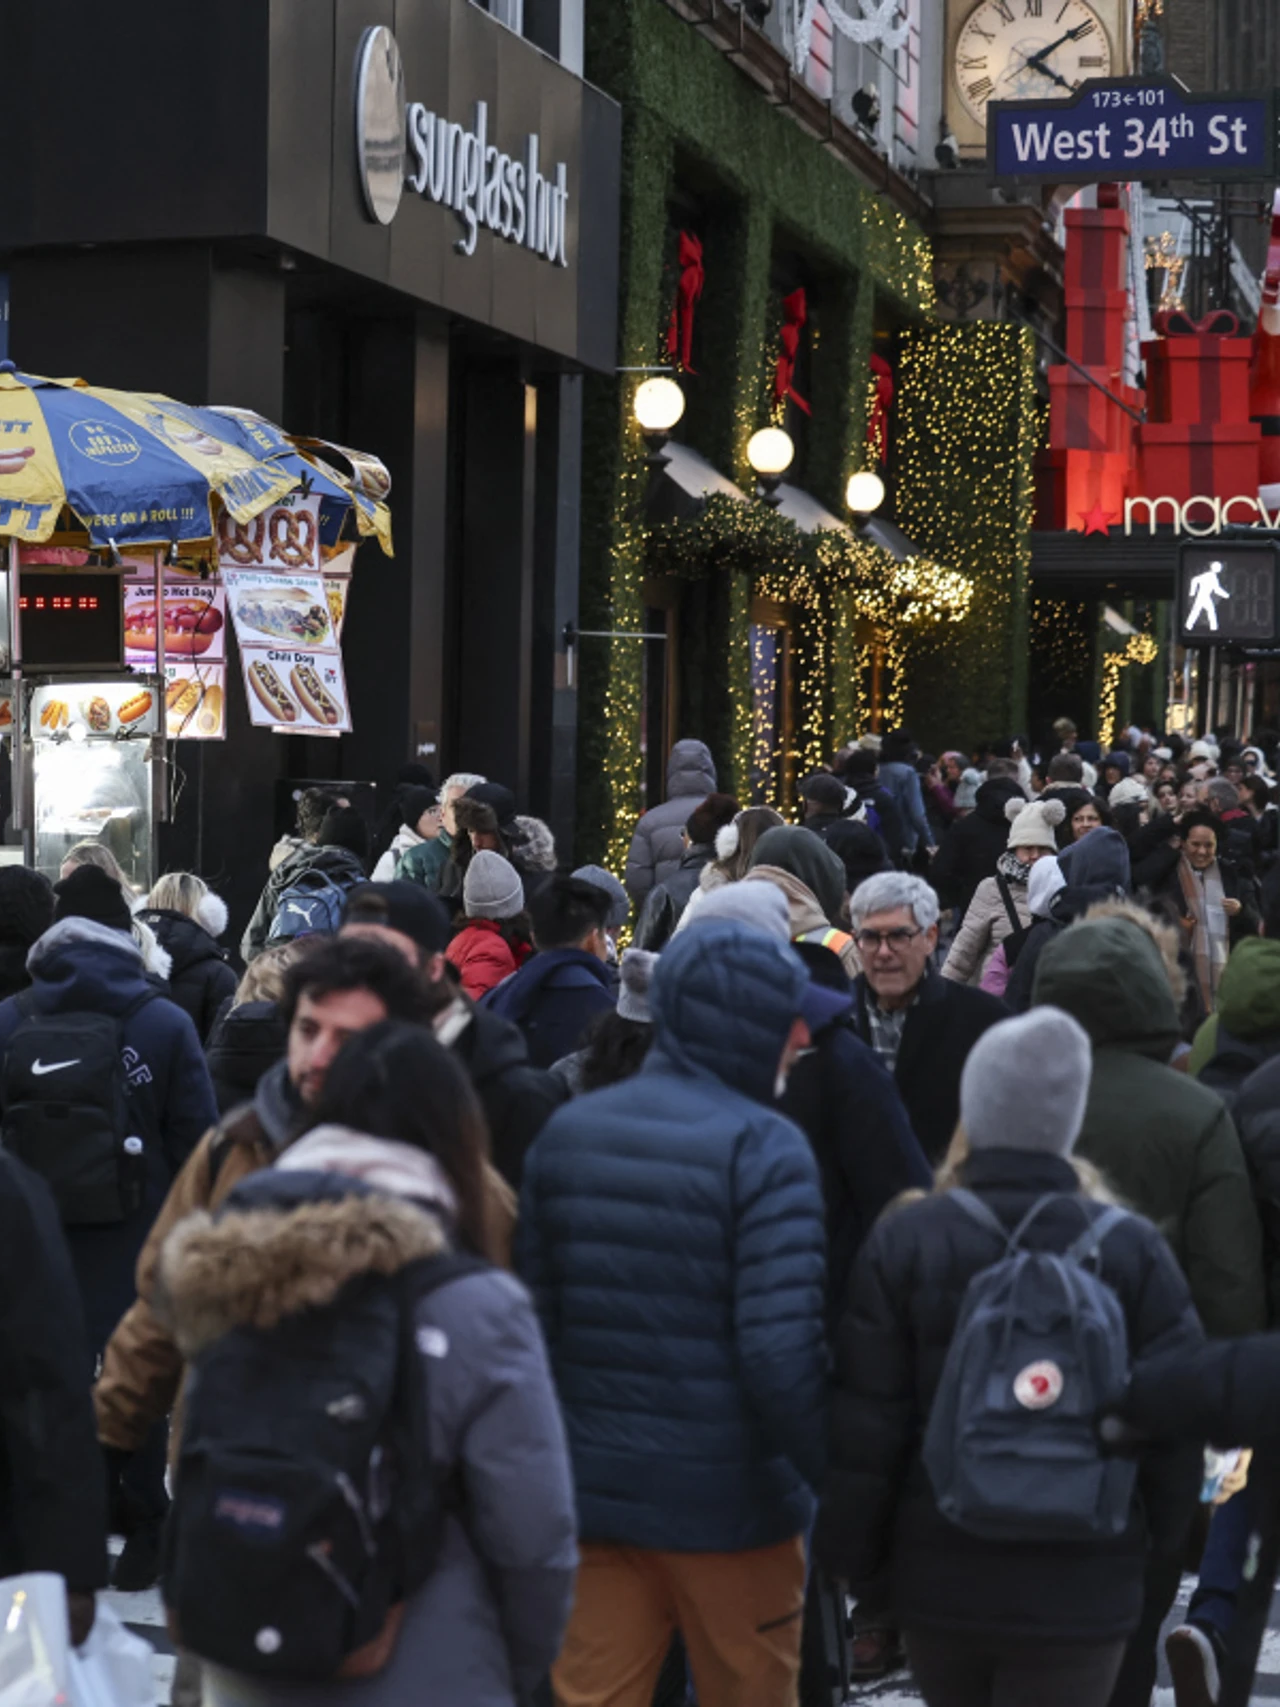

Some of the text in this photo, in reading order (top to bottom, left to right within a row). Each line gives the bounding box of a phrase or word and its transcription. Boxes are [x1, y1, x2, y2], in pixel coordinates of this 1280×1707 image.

[1092, 89, 1165, 108] 173 101
[1011, 122, 1111, 162] West
[1123, 113, 1194, 158] 34th
[1207, 114, 1248, 155] St
[406, 101, 569, 268] sunglass hut
[121, 513, 137, 525] ON
[140, 511, 149, 523] A
[150, 509, 178, 522] ROLL
[171, 587, 190, 597] Hot
[267, 650, 315, 667] Chili Dog
